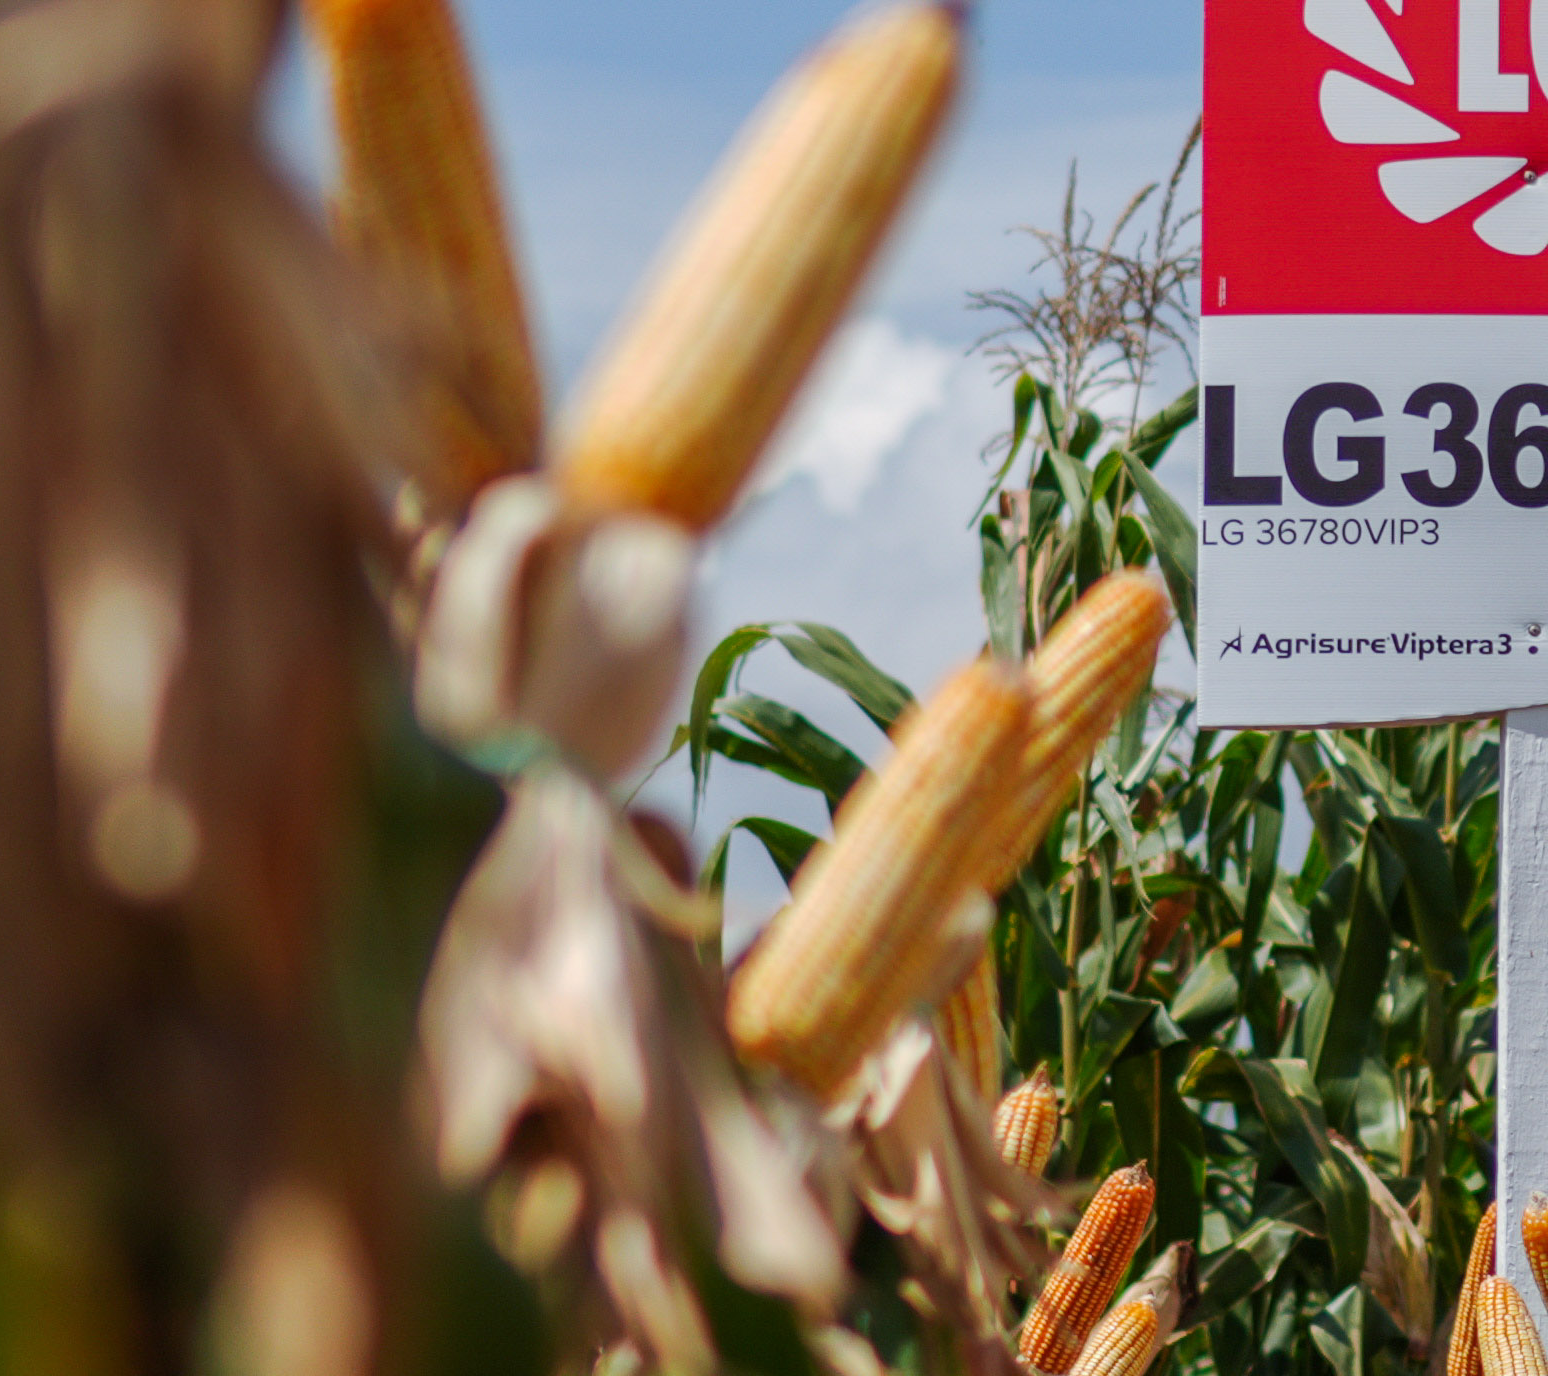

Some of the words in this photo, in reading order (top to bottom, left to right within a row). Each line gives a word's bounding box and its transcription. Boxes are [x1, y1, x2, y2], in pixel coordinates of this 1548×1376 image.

[1201, 518, 1244, 546] LG
[1255, 517, 1441, 546] 36780VIP3
[1251, 632, 1386, 659] Agrisure
